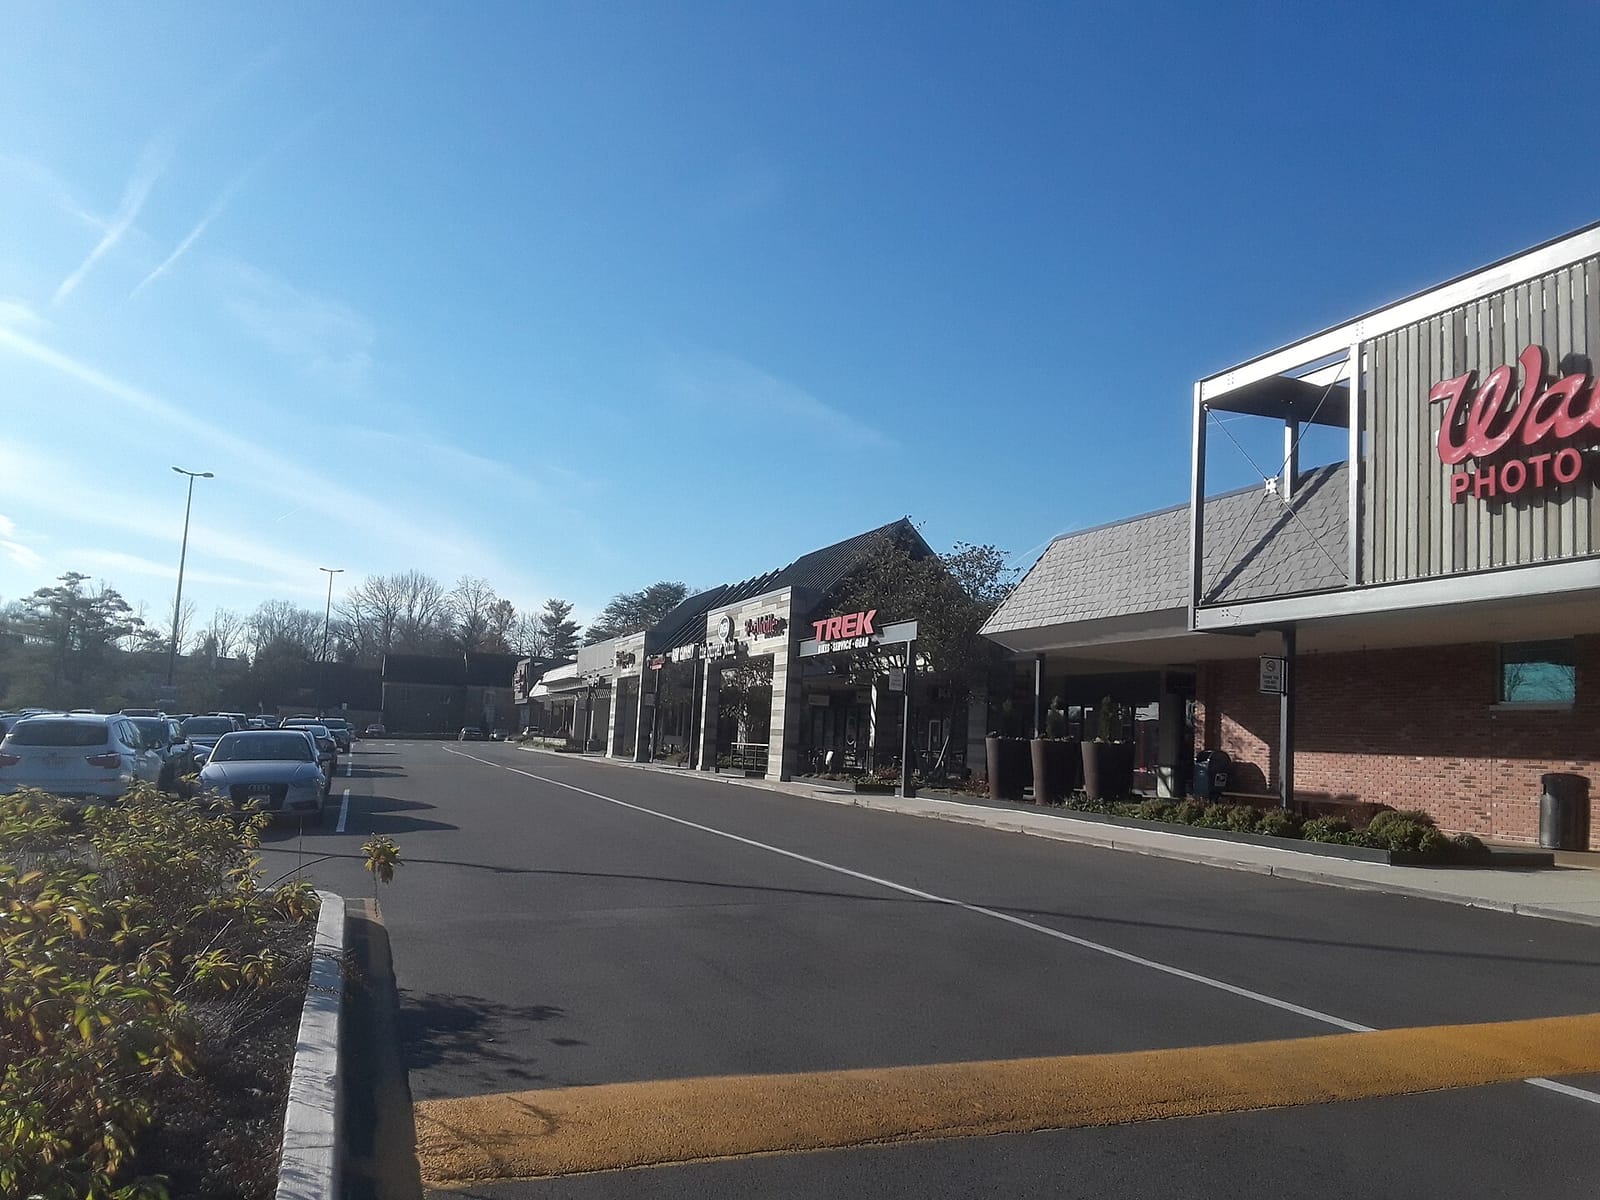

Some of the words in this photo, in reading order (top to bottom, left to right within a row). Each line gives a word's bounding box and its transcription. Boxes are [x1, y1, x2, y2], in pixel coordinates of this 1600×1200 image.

[1451, 447, 1583, 504] PHOTO
[812, 609, 877, 643] TREK
[854, 636, 869, 648] GEAR
